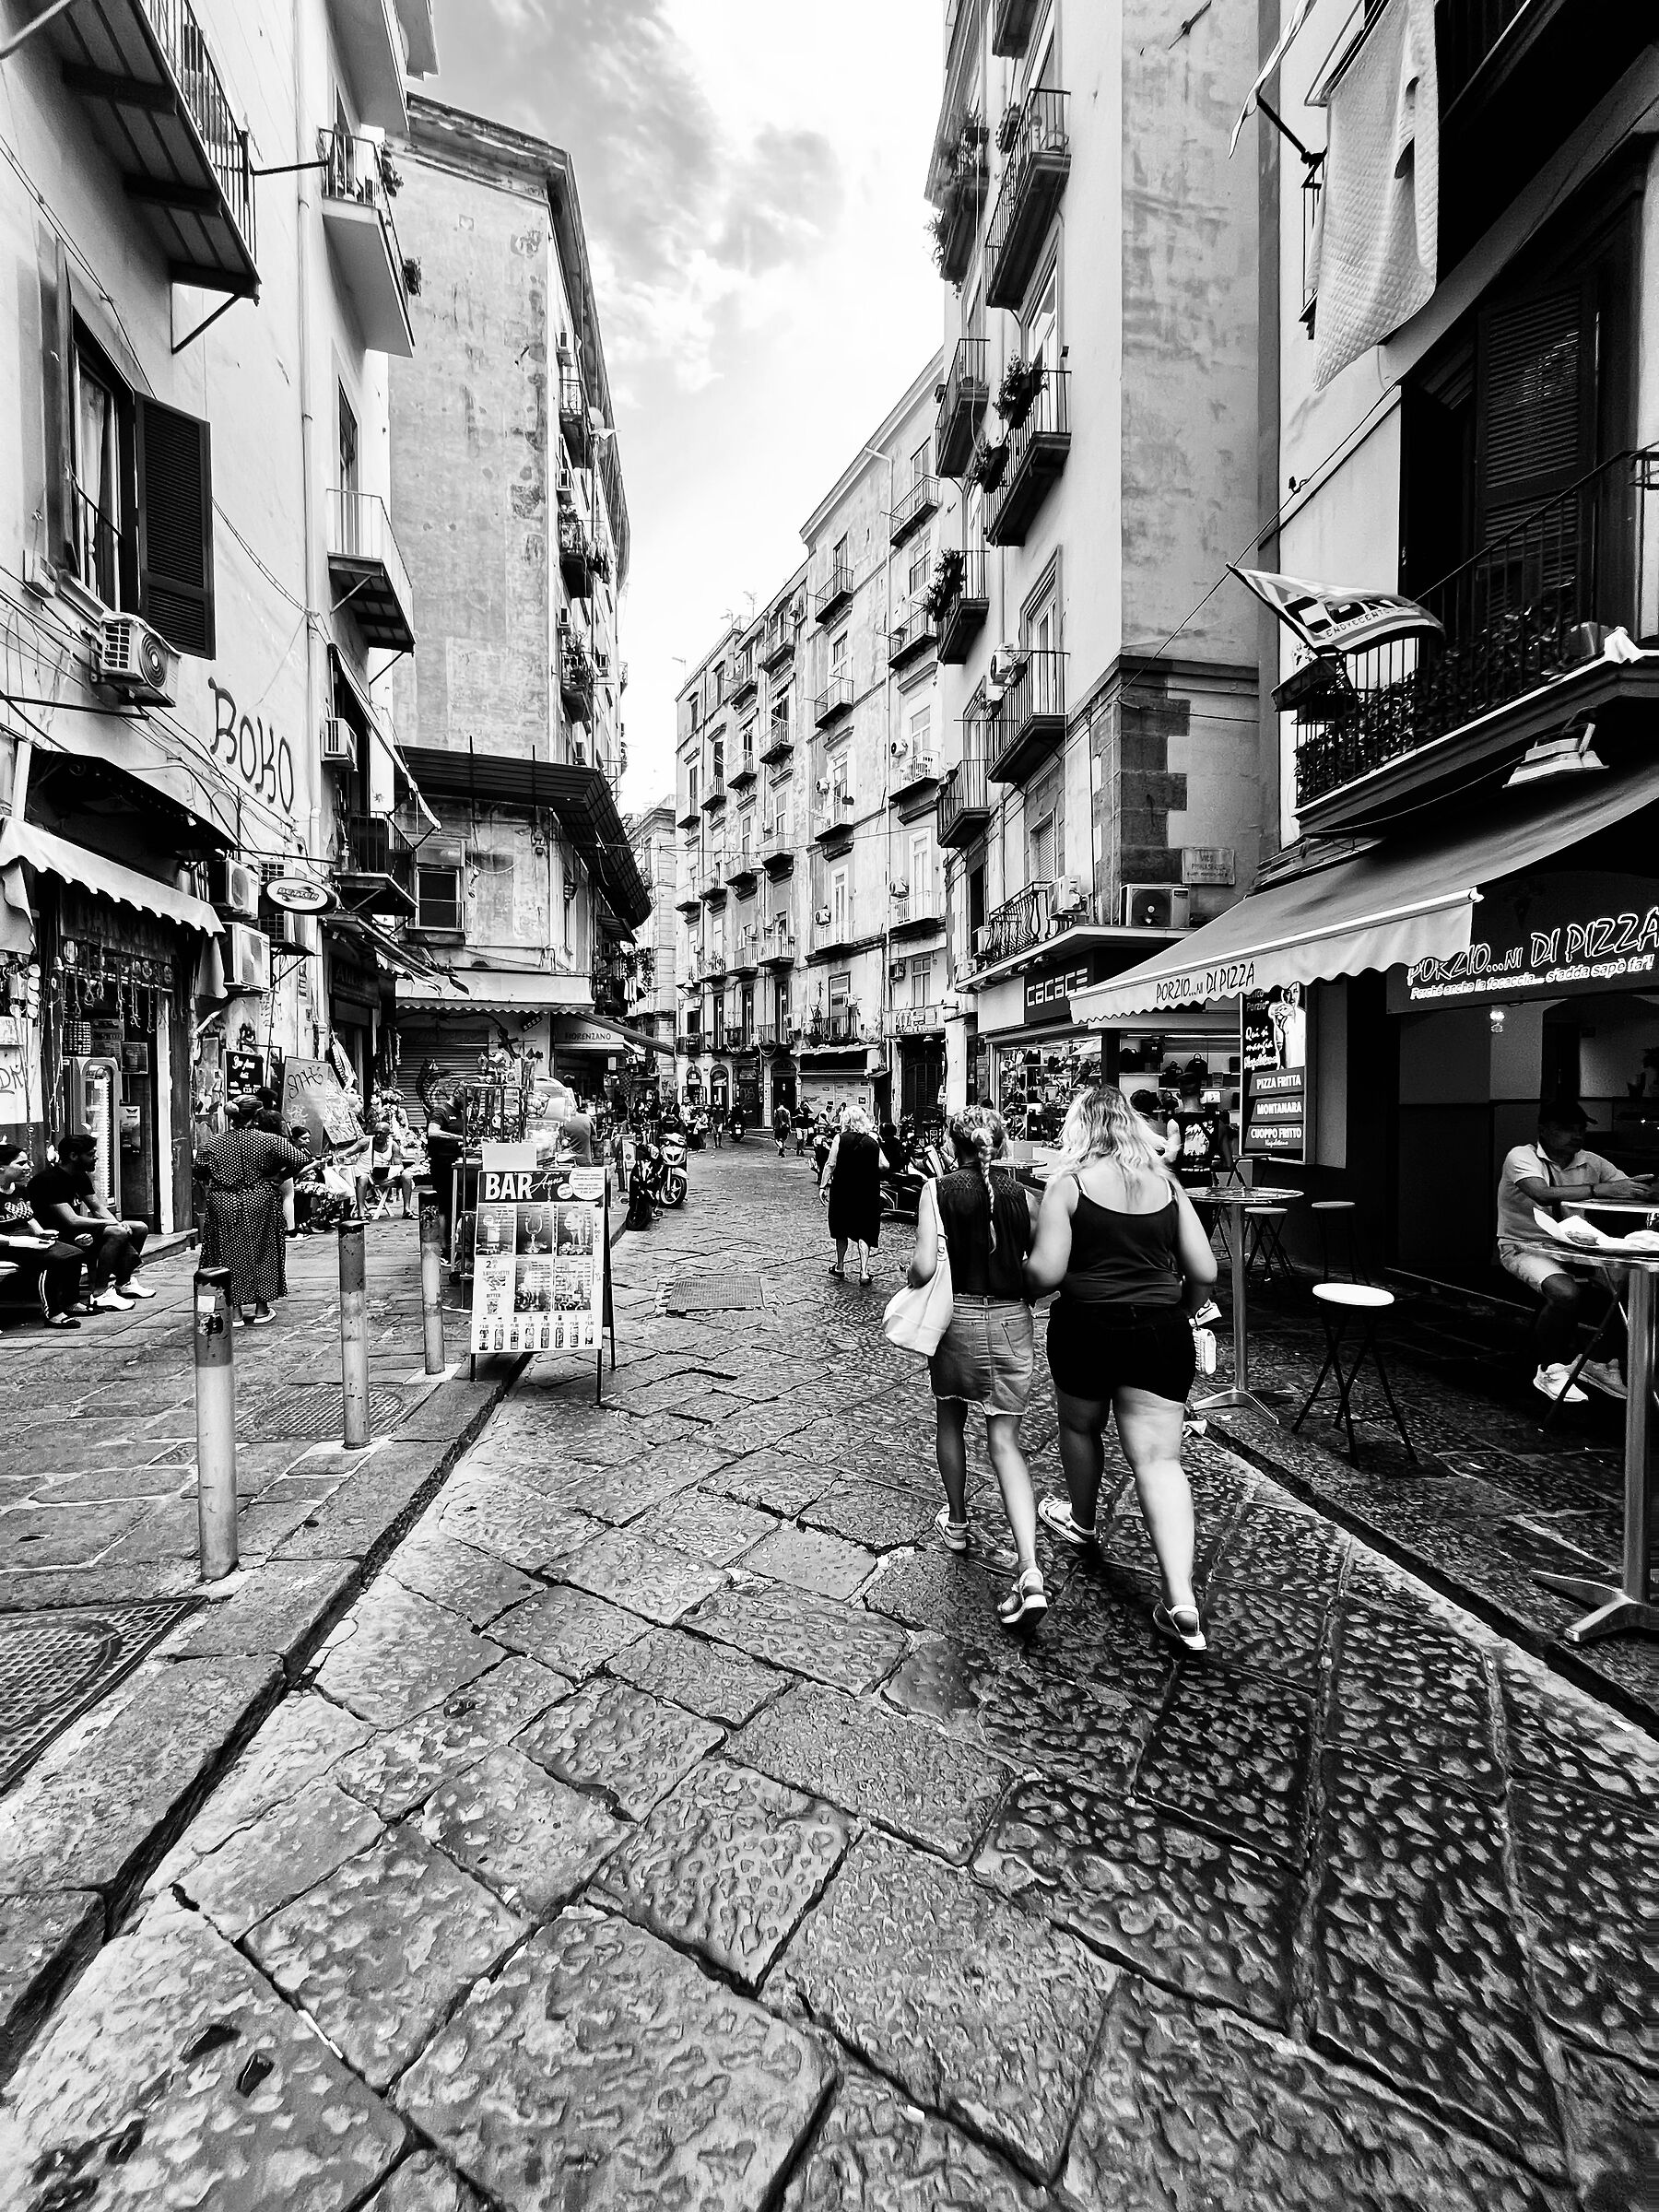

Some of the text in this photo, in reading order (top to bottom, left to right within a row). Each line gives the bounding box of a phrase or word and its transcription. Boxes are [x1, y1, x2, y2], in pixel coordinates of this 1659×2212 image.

[1531, 928, 1560, 968] DI
[1565, 907, 1659, 963] PIZZA
[1206, 971, 1218, 994] DI
[1219, 961, 1254, 992] PIZZA
[565, 1032, 611, 1041] FIORENZANO
[1256, 1075, 1301, 1089] PIZZA FRITTA
[1256, 1101, 1302, 1114] MONTANARA
[1251, 1127, 1302, 1138] CUOPPO FRITTO
[485, 1172, 533, 1200] BAR
